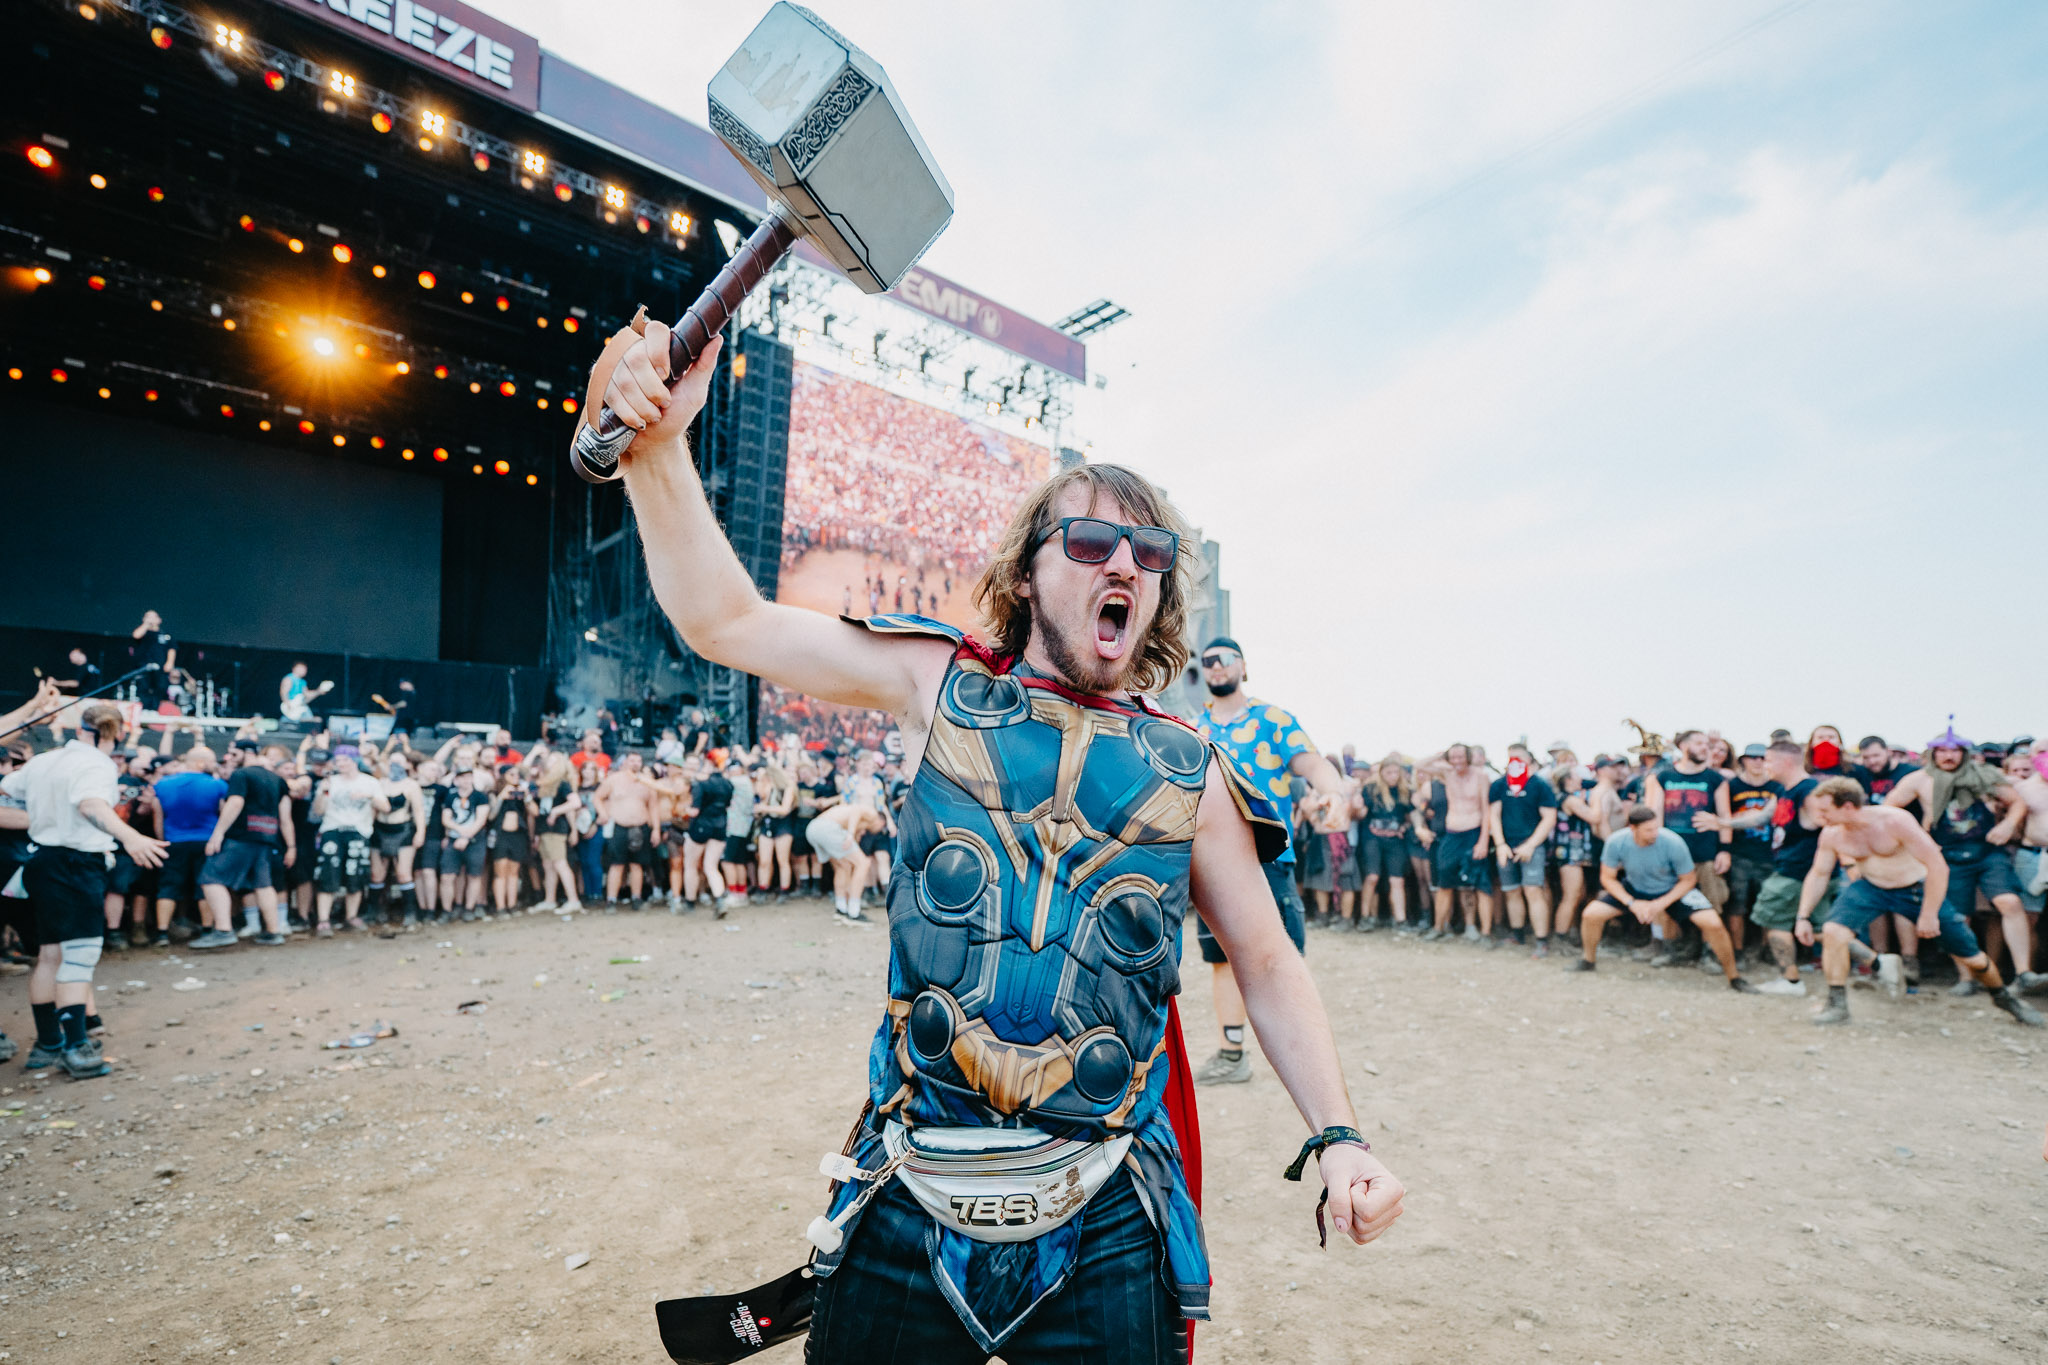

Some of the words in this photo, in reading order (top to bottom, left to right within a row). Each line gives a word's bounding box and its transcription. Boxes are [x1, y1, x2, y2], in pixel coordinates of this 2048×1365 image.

[900, 271, 979, 323] EMP
[950, 1193, 1038, 1226] TBS
[730, 1318, 747, 1338] CLUB
[736, 1305, 763, 1345] BACKSTAGE
